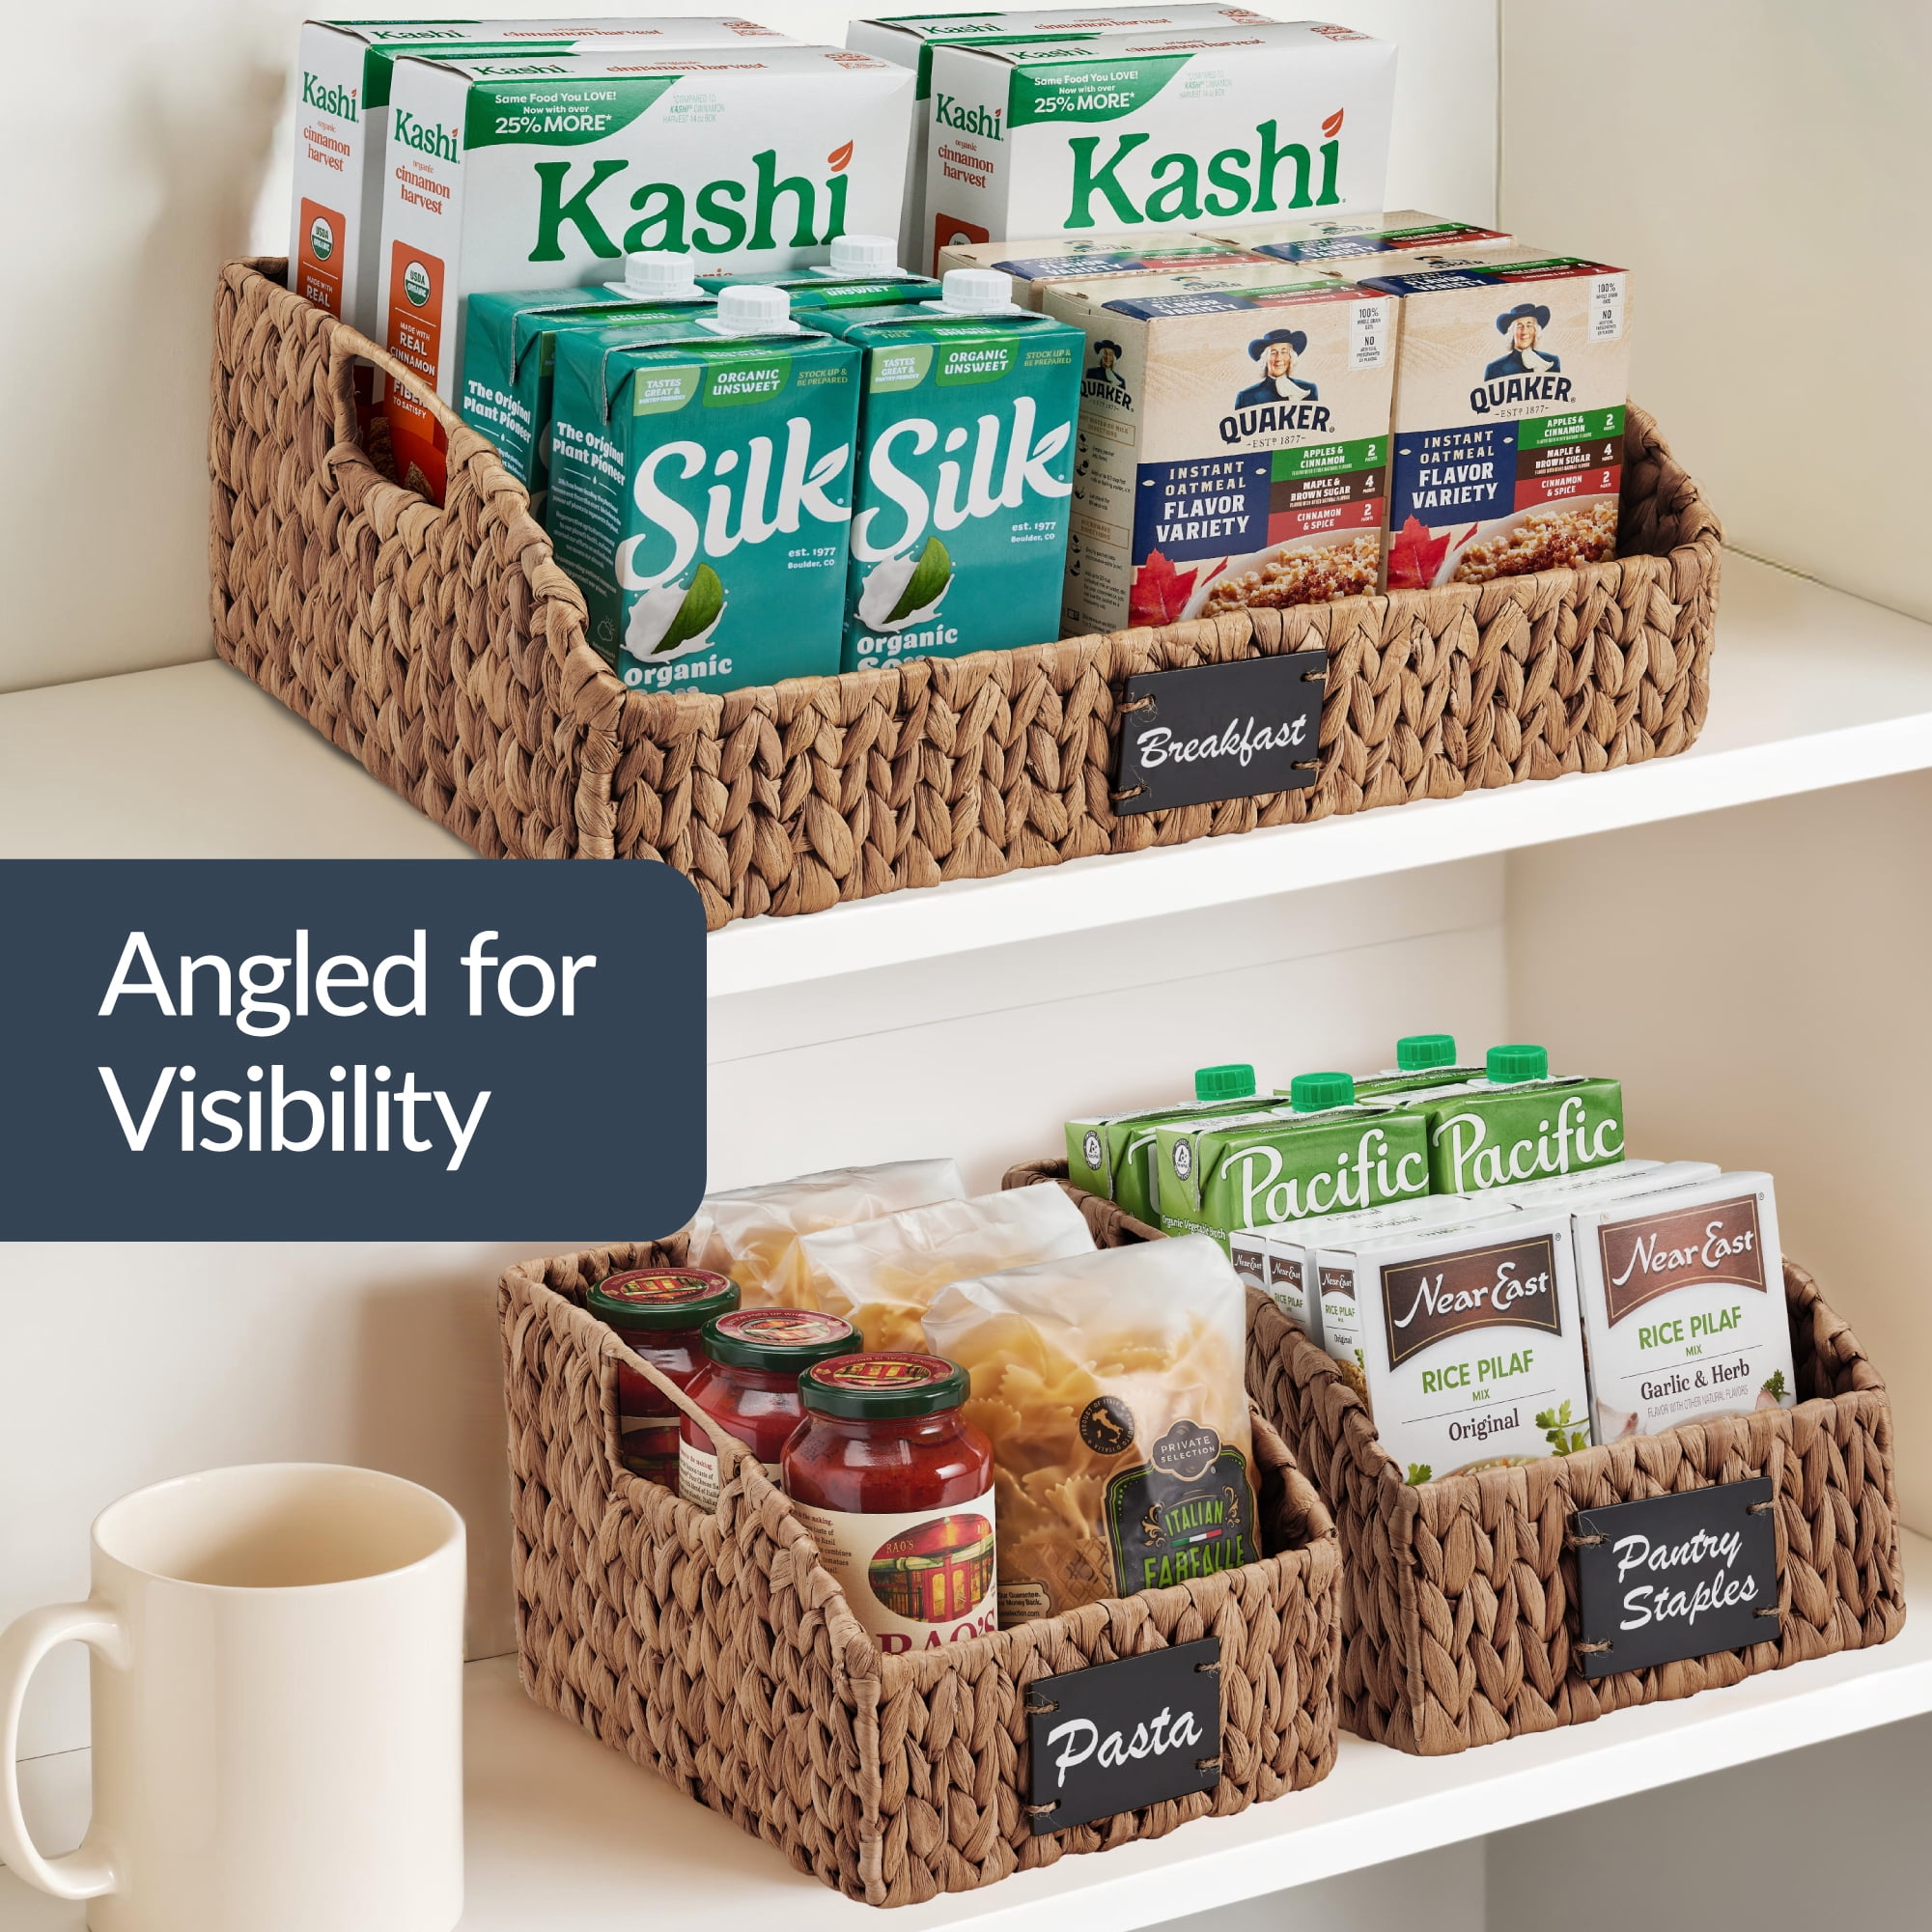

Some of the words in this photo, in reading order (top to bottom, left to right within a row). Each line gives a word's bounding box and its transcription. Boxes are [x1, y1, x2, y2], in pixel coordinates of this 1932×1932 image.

[370, 29, 469, 40] Kashi
[919, 23, 1004, 35] Kashi
[1011, 47, 1094, 60] Kashi
[470, 64, 572, 75] Kashi
[1034, 76, 1062, 86] Same
[1064, 75, 1088, 84] Food
[1090, 74, 1109, 83] You
[1110, 70, 1138, 81] LOVE!
[302, 71, 359, 124] Kashi
[494, 95, 527, 104] Same
[529, 93, 558, 103] Food
[560, 92, 581, 102] You
[583, 91, 617, 101] LOVE!
[1034, 97, 1075, 113] 25%
[543, 104, 566, 113] with
[936, 93, 1003, 142] Kashi
[494, 116, 542, 134] 25%
[303, 126, 350, 156] cinnamon
[394, 108, 461, 164] Kashi
[308, 144, 344, 172] harvest
[938, 144, 994, 174] cinnamon
[942, 161, 987, 189] harvest
[1063, 107, 1347, 229] Kashi
[395, 165, 451, 199] cinnamon
[401, 184, 443, 215] harvest
[527, 139, 854, 262] Kashi
[409, 269, 426, 286] USDA
[306, 285, 331, 308] REAL
[1598, 282, 1616, 293] 100%
[1358, 307, 1379, 319] 100%
[1602, 309, 1612, 320] NO
[400, 321, 416, 334] MADE
[415, 327, 431, 341] WITH
[400, 331, 428, 356] REAL
[1364, 336, 1375, 346] NO
[390, 347, 435, 377] CINNAMON
[882, 357, 916, 368] TASTES
[949, 349, 1008, 363] ORGANIC
[717, 369, 780, 384] ORGANIC
[944, 360, 1009, 375] UNSWEET
[646, 378, 682, 389] TASTES
[713, 379, 781, 396] UNSWEET
[468, 379, 493, 401] The
[494, 390, 531, 426] Original
[1079, 380, 1134, 412] QUAKER
[1470, 376, 1573, 413] QUAKER
[463, 397, 498, 421] Plant
[499, 410, 532, 444] Pioneer
[1219, 405, 1330, 445] QUAKER
[1547, 416, 1577, 428] APPLES
[1606, 413, 1613, 426] 2
[1424, 430, 1494, 449] INSTANT
[1544, 424, 1585, 437] CINNAMON
[556, 421, 584, 442] The
[585, 431, 625, 467] Original
[1303, 446, 1335, 459] APPLES
[1337, 445, 1343, 454] &
[1367, 443, 1376, 457] 2
[1547, 447, 1574, 459] MAPLE
[1575, 445, 1581, 454] &
[1604, 443, 1612, 456] 4
[552, 437, 590, 464] Plant
[591, 451, 626, 487] Pioneer
[1300, 455, 1345, 469] CINNAMON
[1419, 445, 1495, 464] OATMEAL
[1535, 458, 1564, 469] BROWN
[1565, 453, 1591, 464] SUGAR
[851, 396, 1073, 563] Silk
[1168, 461, 1245, 481] INSTANT
[1418, 462, 1494, 487] FLAVOR
[1603, 471, 1610, 484] 2
[1164, 476, 1246, 497] OATMEAL
[1302, 478, 1332, 490] MAPLE
[1333, 477, 1340, 486] &
[1365, 474, 1374, 488] 4
[1541, 475, 1582, 489] CINNAMON
[1290, 489, 1322, 502] BROWN
[1324, 485, 1351, 497] SUGAR
[1412, 482, 1498, 509] VARIETY
[1547, 489, 1553, 497] &
[1554, 486, 1576, 496] SPICE
[615, 416, 852, 591] Silk
[1163, 494, 1246, 520] FLAVOR
[1364, 503, 1372, 517] 2
[1297, 508, 1342, 522] CINNAMON
[1311, 518, 1335, 529] SPICE
[1012, 522, 1032, 532] est.
[1034, 521, 1056, 531] 1977
[1156, 515, 1250, 544] VARIETY
[1011, 534, 1044, 543] Boulder,
[788, 548, 809, 557] est.
[812, 546, 836, 556] 1977
[788, 559, 822, 570] Boulder,
[857, 624, 958, 657] Organic
[625, 654, 733, 688] Organic
[1136, 714, 1307, 768] Breakfast
[1432, 1096, 1625, 1195] Pacific
[1221, 1128, 1430, 1228] Pacific
[1162, 1215, 1183, 1230] Organic
[1184, 1218, 1210, 1237] Vegetable
[1208, 1226, 1226, 1241] Broth
[1612, 1233, 1699, 1286] Near
[1701, 1220, 1754, 1269] East
[1394, 1273, 1488, 1328] Near
[1491, 1262, 1549, 1311] East
[1325, 1304, 1338, 1316] RICE
[1339, 1306, 1356, 1317] PILAF
[1638, 1320, 1685, 1350] RICE
[1690, 1305, 1742, 1338] PILAF
[1333, 1333, 1352, 1346] Original
[1686, 1343, 1702, 1358] MIX
[1421, 1362, 1471, 1394] RICE
[1477, 1349, 1534, 1383] PILAF
[1640, 1374, 1691, 1401] Garlic
[1694, 1370, 1709, 1387] &
[1712, 1358, 1750, 1385] Herb
[1472, 1388, 1491, 1402] MIX
[1449, 1408, 1520, 1442] Original
[1161, 1435, 1211, 1454] PRIVATE
[1161, 1444, 1216, 1464] SELECTION
[1164, 1499, 1224, 1536] ITALIAN
[824, 1547, 852, 1557] combines
[885, 1539, 914, 1554] RAO'S
[1612, 1528, 1743, 1583] Pantry
[1144, 1534, 1245, 1590] FARFALLE
[1619, 1569, 1759, 1631] Staples
[876, 1608, 995, 1655] RAO'S
[1047, 1706, 1203, 1788] Pasta
